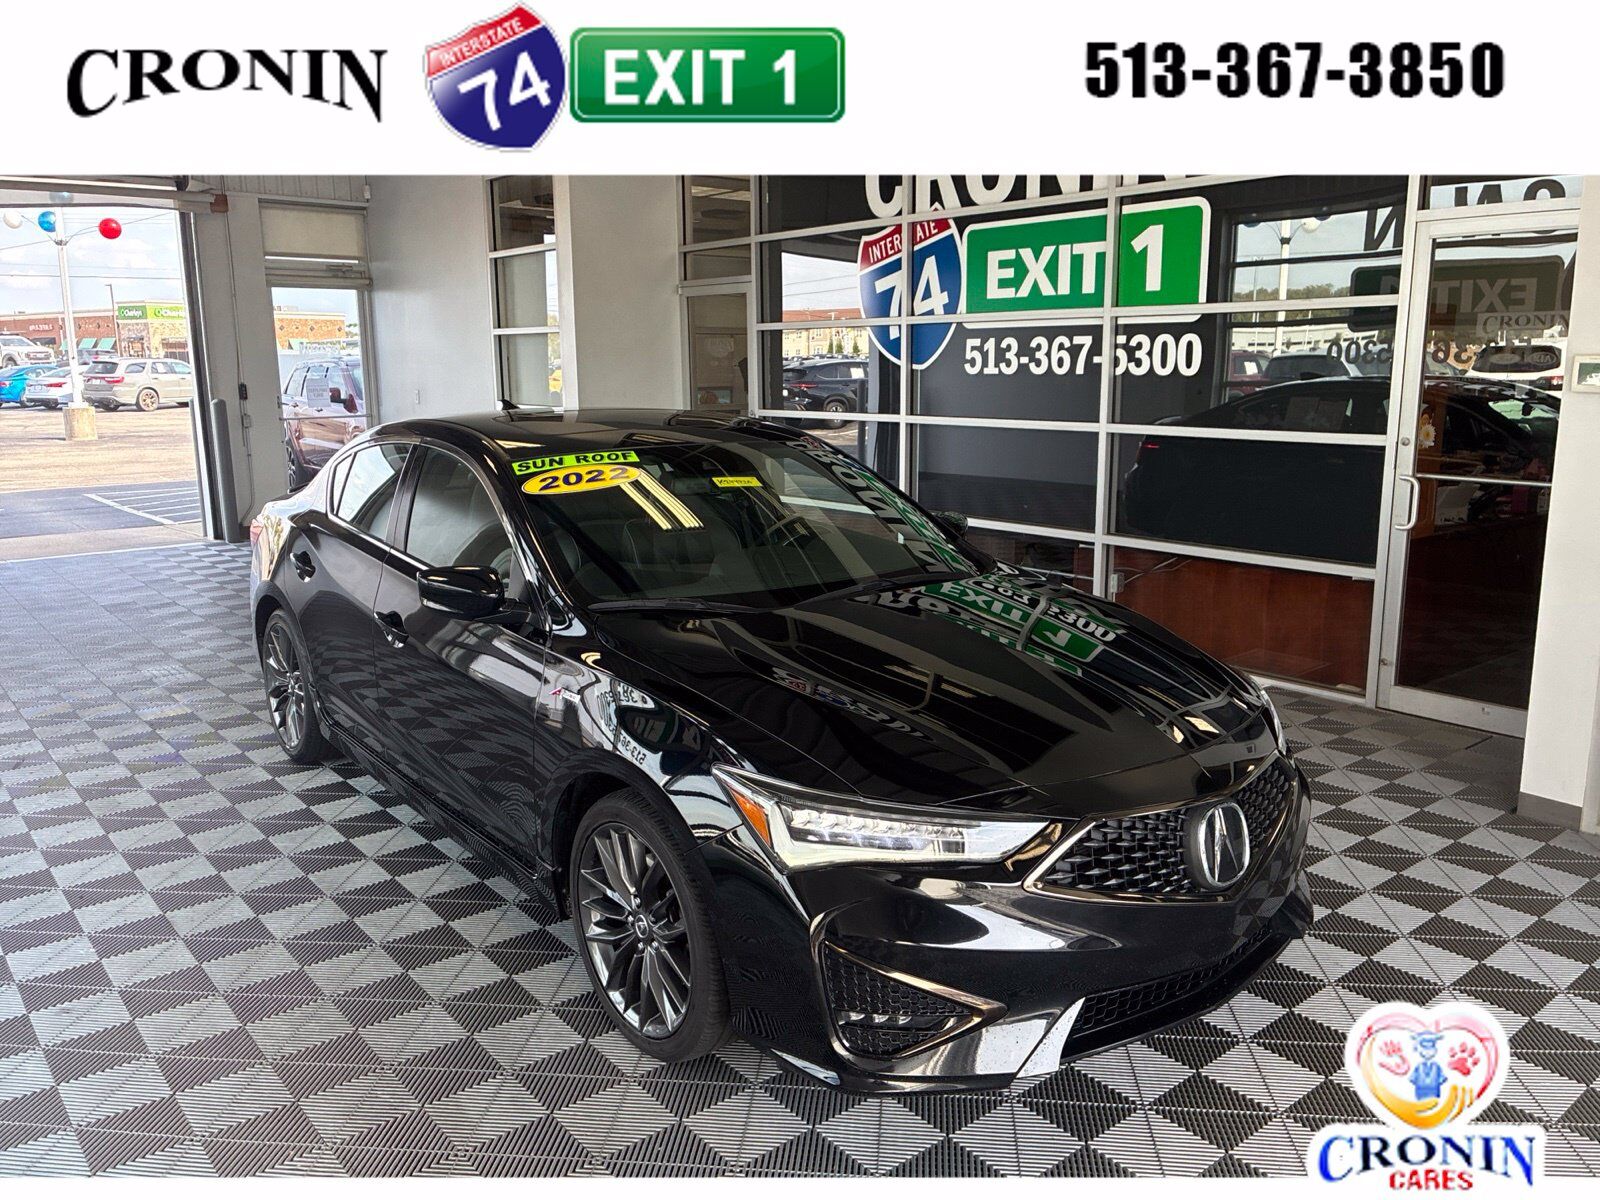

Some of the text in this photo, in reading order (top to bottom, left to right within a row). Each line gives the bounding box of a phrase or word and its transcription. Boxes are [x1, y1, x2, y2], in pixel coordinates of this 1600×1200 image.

[986, 224, 1164, 300] EXIT 1
[874, 254, 949, 341] 74
[516, 452, 634, 473] SUN ROOF
[538, 465, 631, 492] 2022
